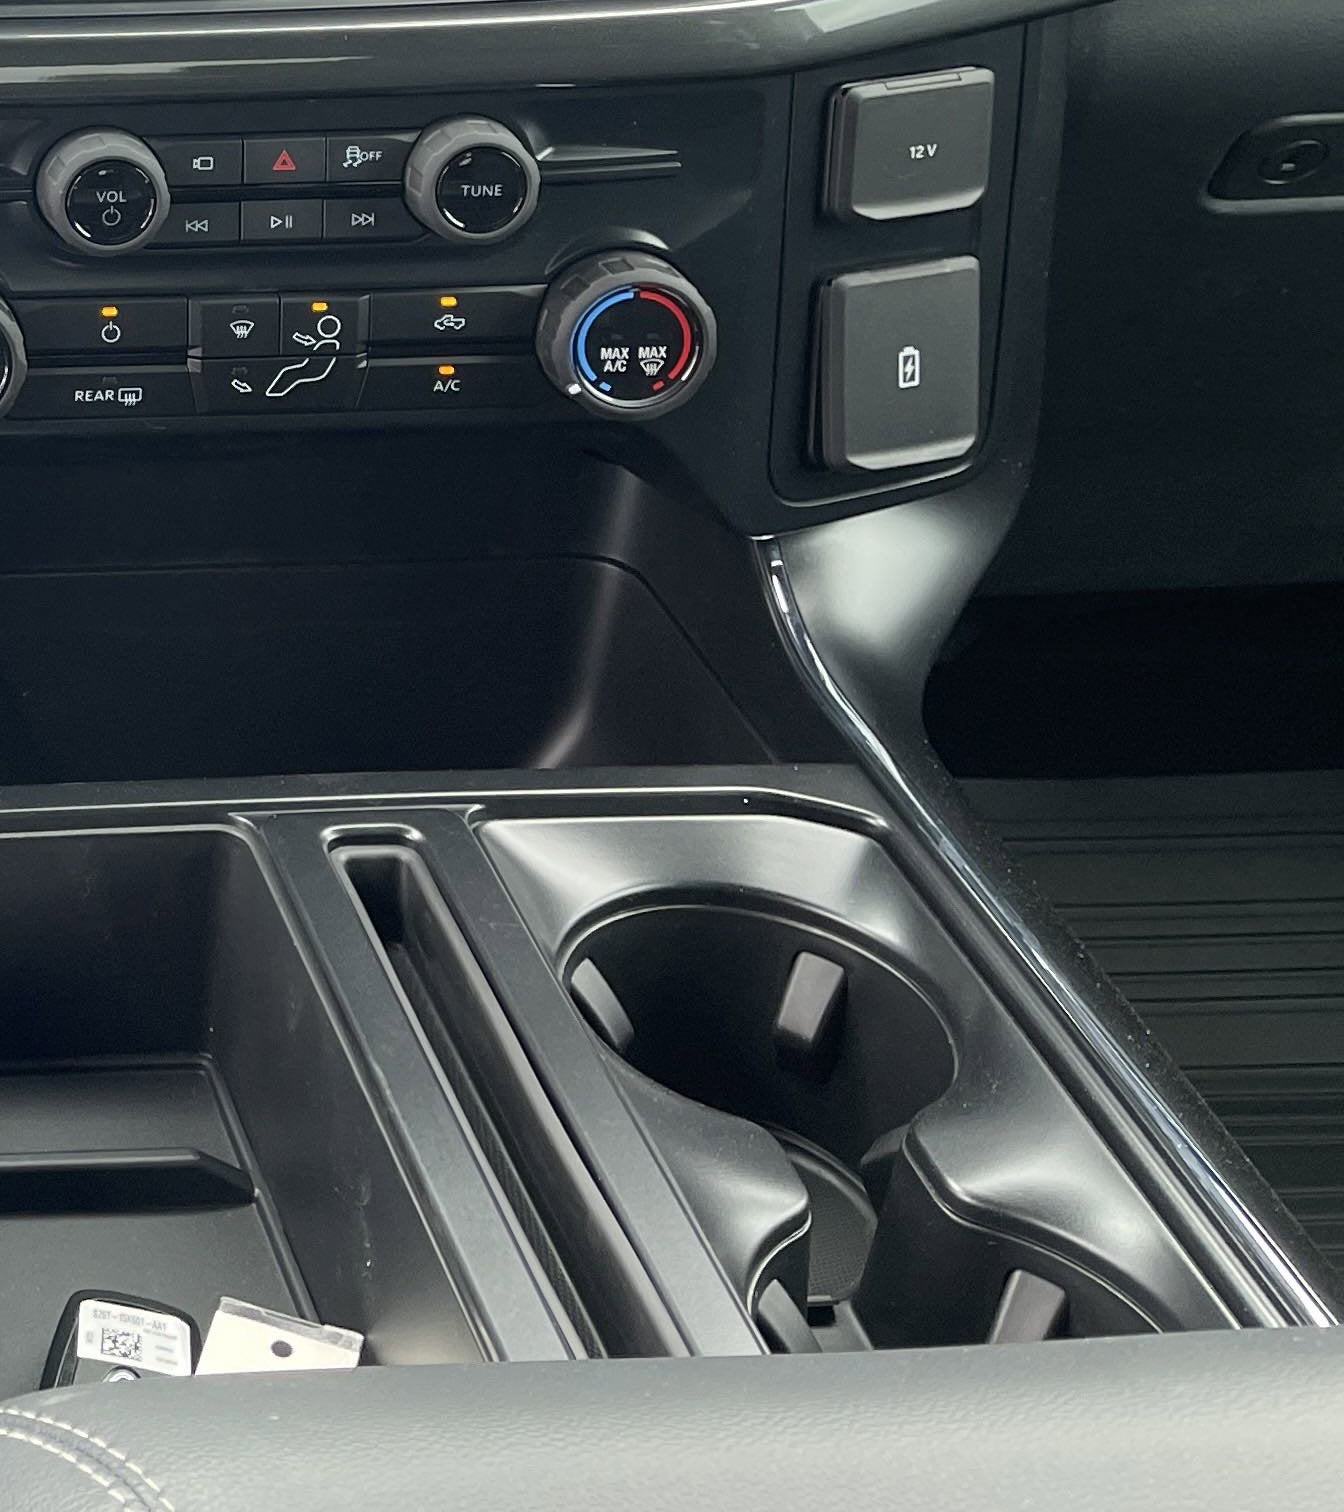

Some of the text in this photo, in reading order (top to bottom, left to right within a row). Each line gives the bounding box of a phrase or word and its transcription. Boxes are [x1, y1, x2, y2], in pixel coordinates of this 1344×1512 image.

[359, 149, 383, 162] OFF
[95, 190, 128, 204] VOL
[460, 183, 504, 198] TUNE
[599, 346, 630, 361] MAX
[637, 345, 668, 360] MAX
[602, 359, 628, 374] A/C
[432, 378, 462, 393] A/C
[73, 389, 115, 403] REAR
